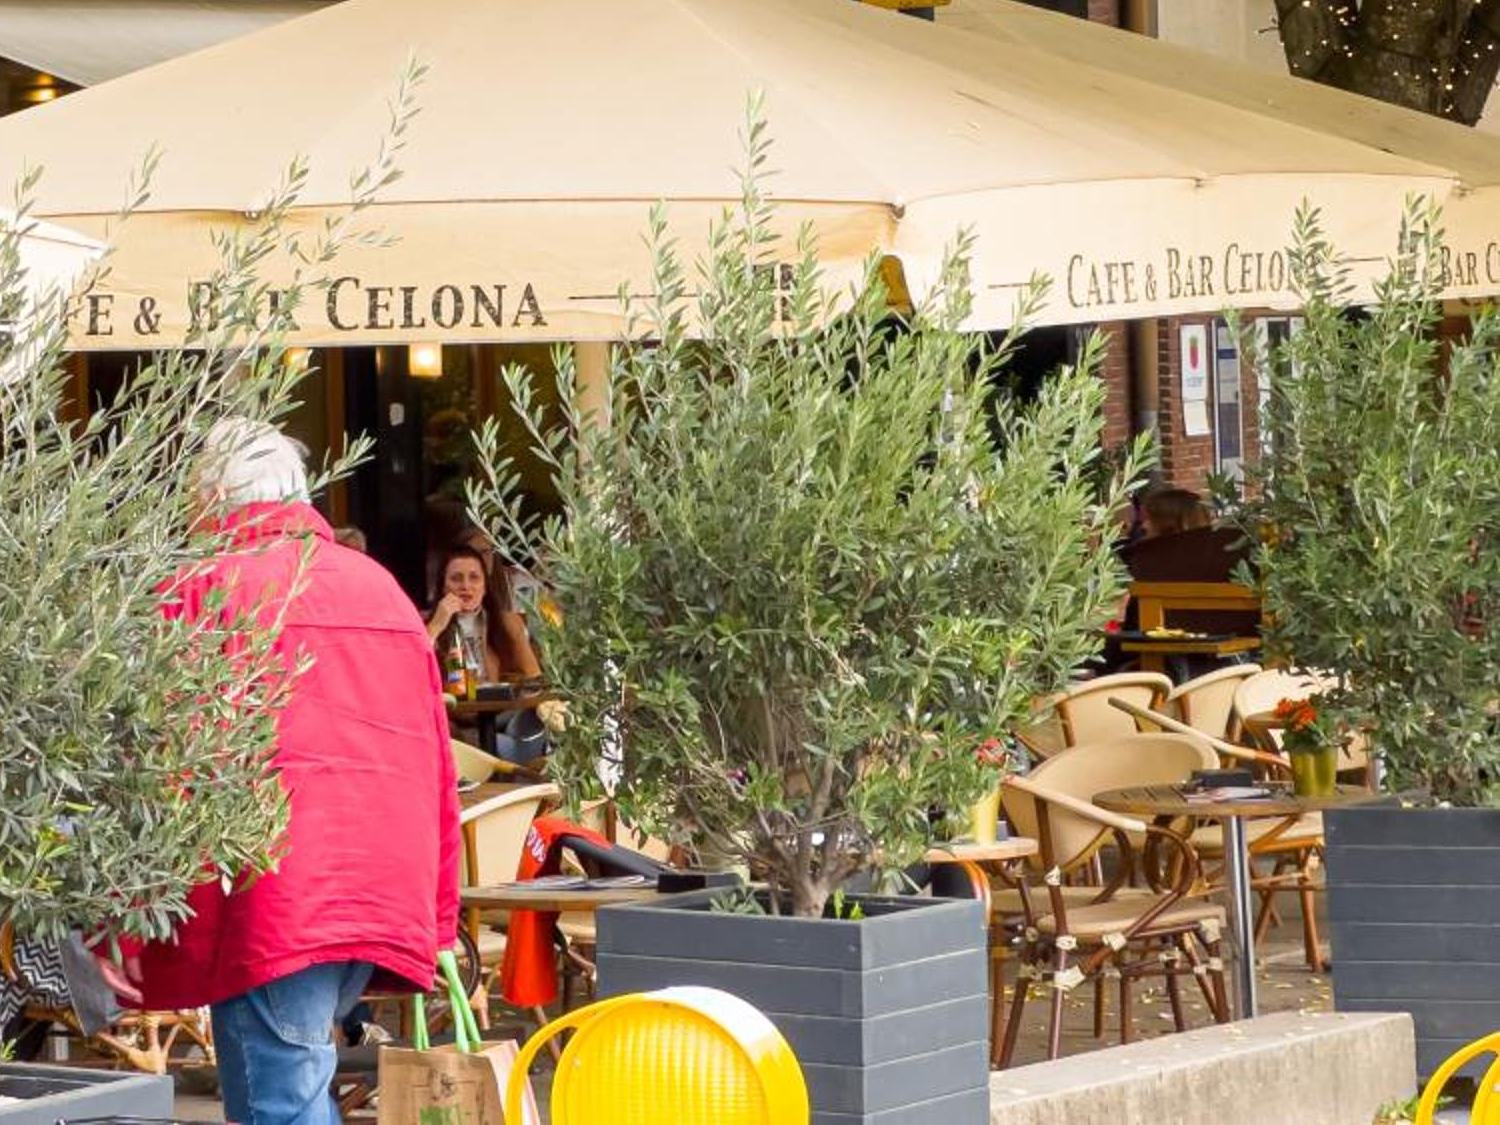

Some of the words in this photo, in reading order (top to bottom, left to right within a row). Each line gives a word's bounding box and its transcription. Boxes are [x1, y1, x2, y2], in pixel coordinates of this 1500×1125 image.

[1067, 254, 1138, 308] CAFE
[1145, 262, 1158, 302] &
[1166, 247, 1215, 299] BAR
[1440, 245, 1479, 287] BAR
[133, 296, 161, 335] &
[326, 276, 547, 330] CELONA
